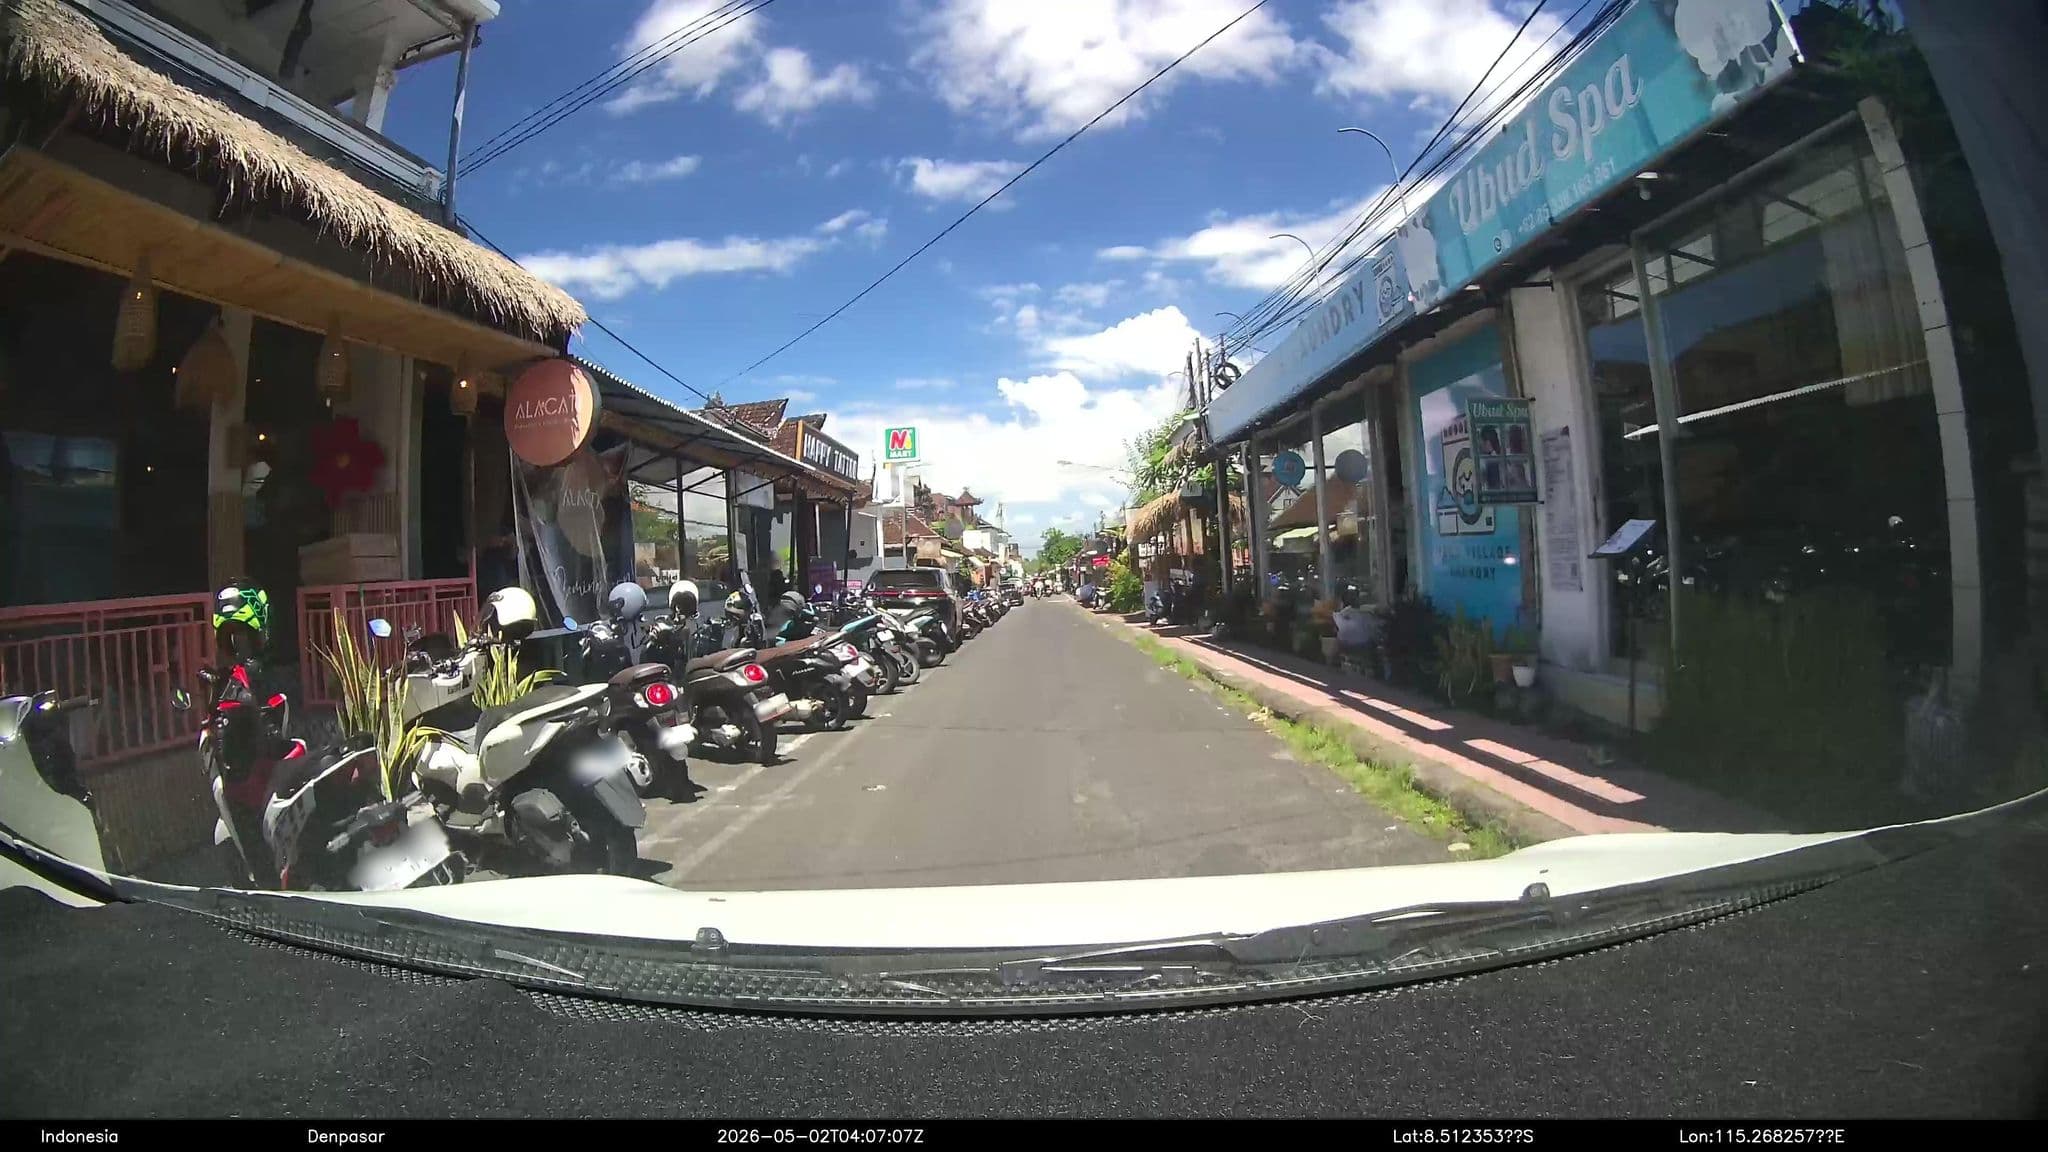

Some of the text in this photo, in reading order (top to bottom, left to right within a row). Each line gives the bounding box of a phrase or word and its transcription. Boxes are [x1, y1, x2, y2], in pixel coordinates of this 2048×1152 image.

[1450, 119, 1544, 235] Ubud
[1549, 53, 1643, 163] Spa
[804, 433, 831, 467] HAPPY
